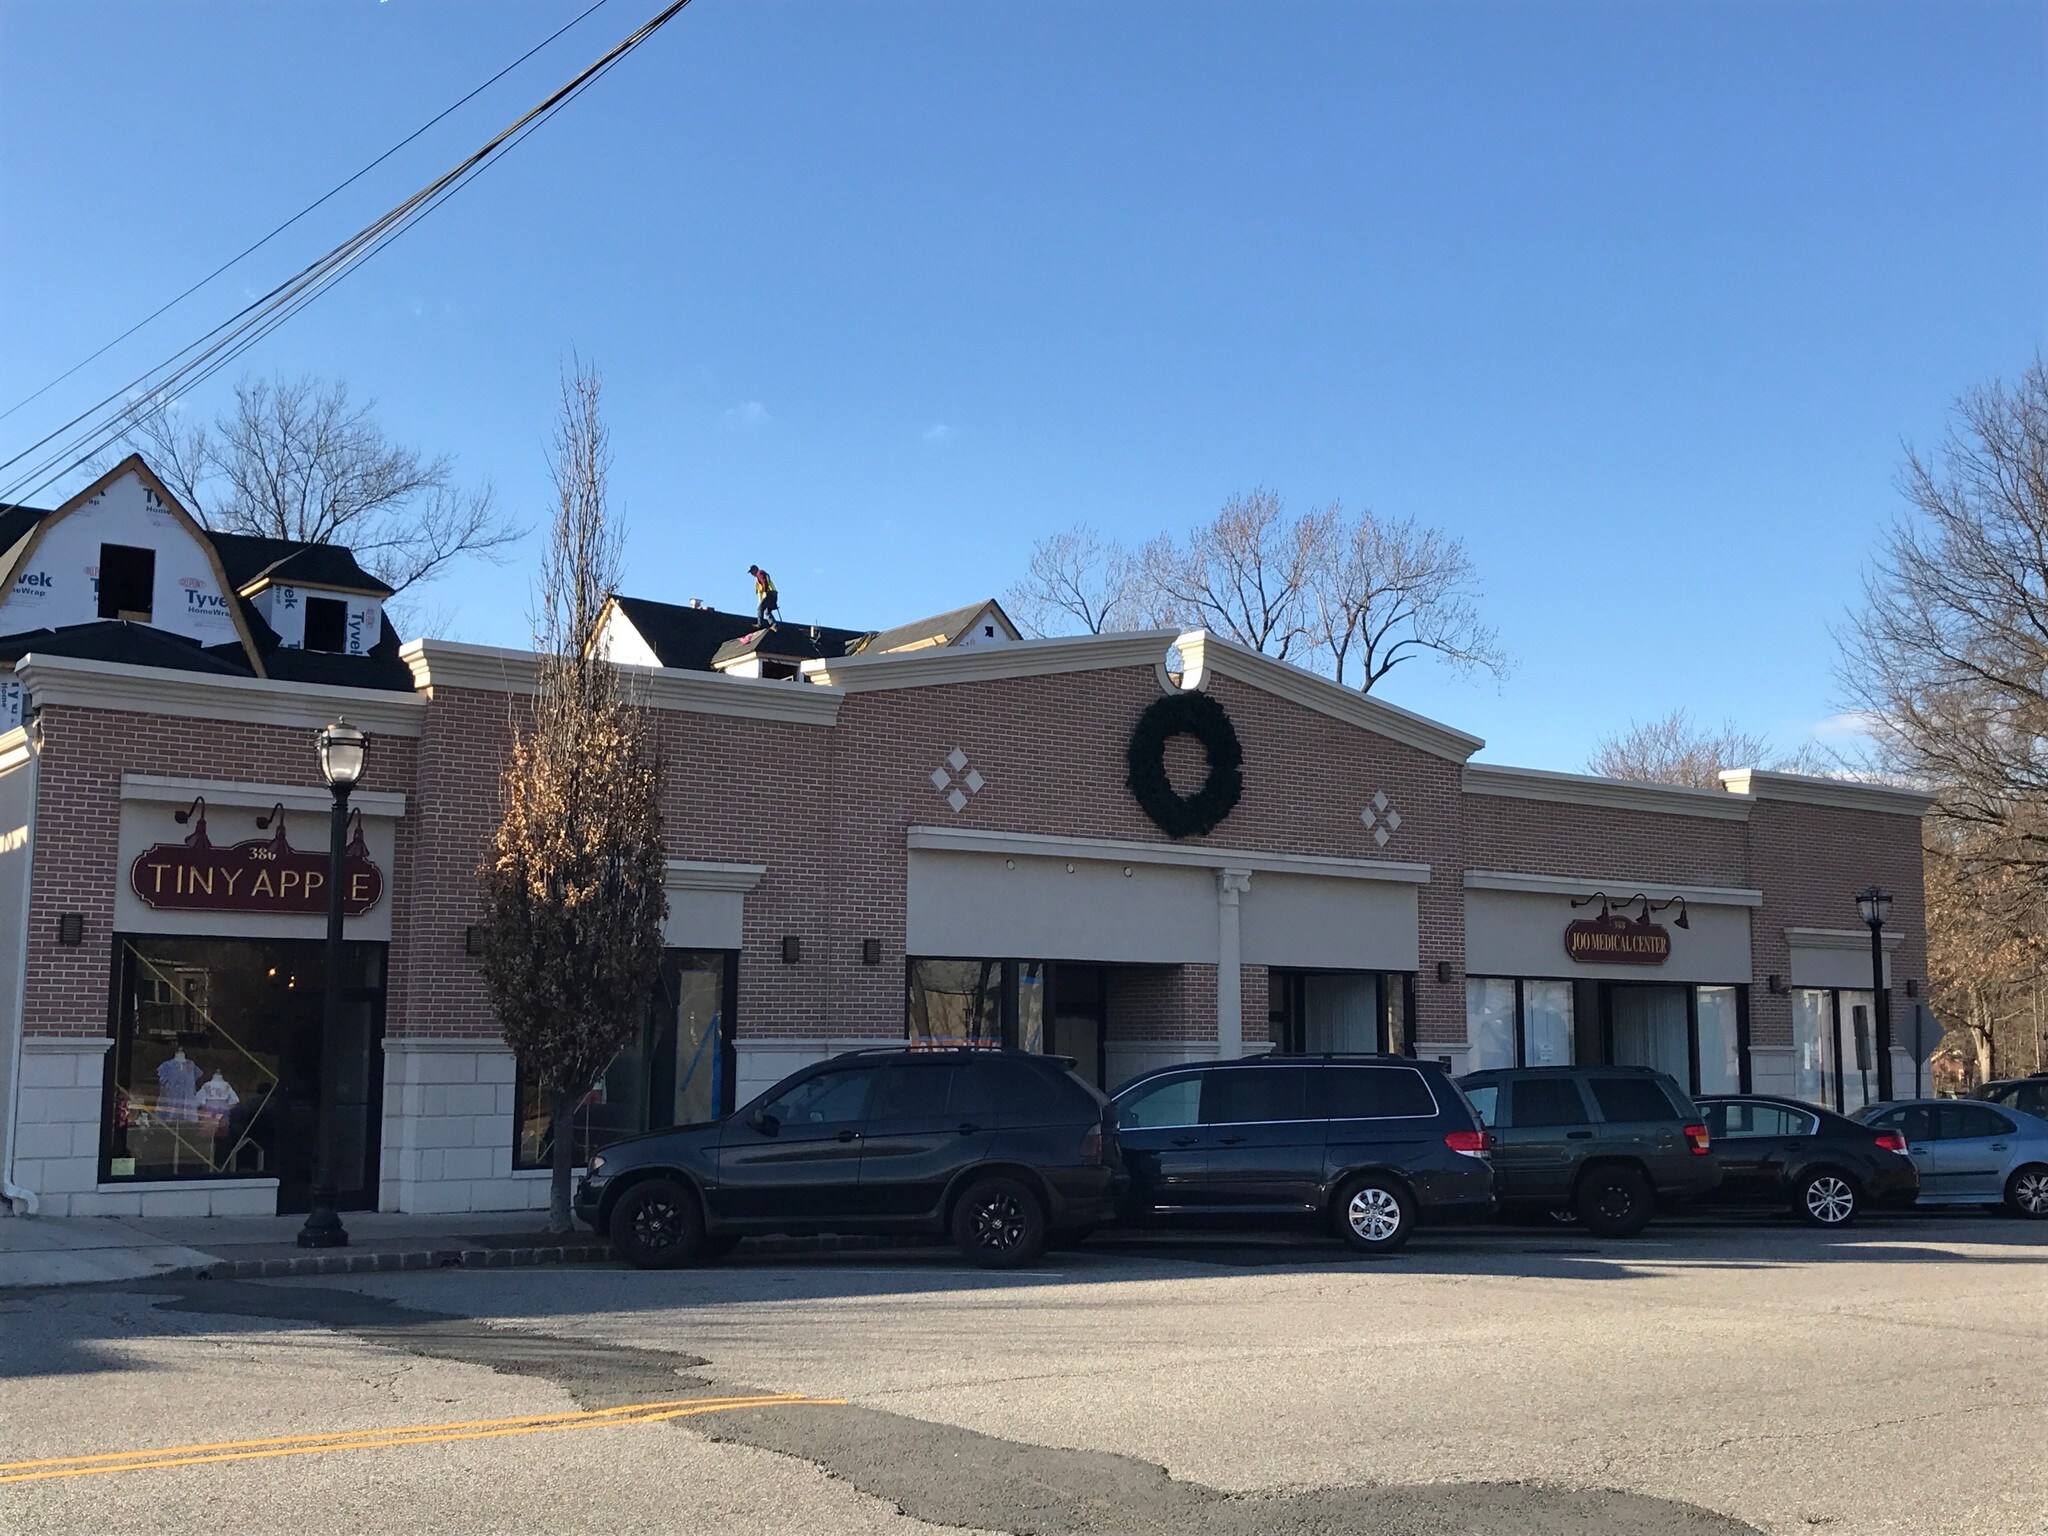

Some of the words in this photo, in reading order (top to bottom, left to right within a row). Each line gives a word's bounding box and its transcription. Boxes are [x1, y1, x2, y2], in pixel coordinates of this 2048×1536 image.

[146, 506, 172, 515] Home
[19, 571, 52, 587] vek
[185, 589, 228, 608] Tyve
[147, 863, 243, 896] TINY
[251, 869, 370, 901] APPE
[1572, 932, 1589, 951] JOO
[1592, 933, 1632, 952] MEDICAL
[1633, 935, 1667, 954] CENTER
